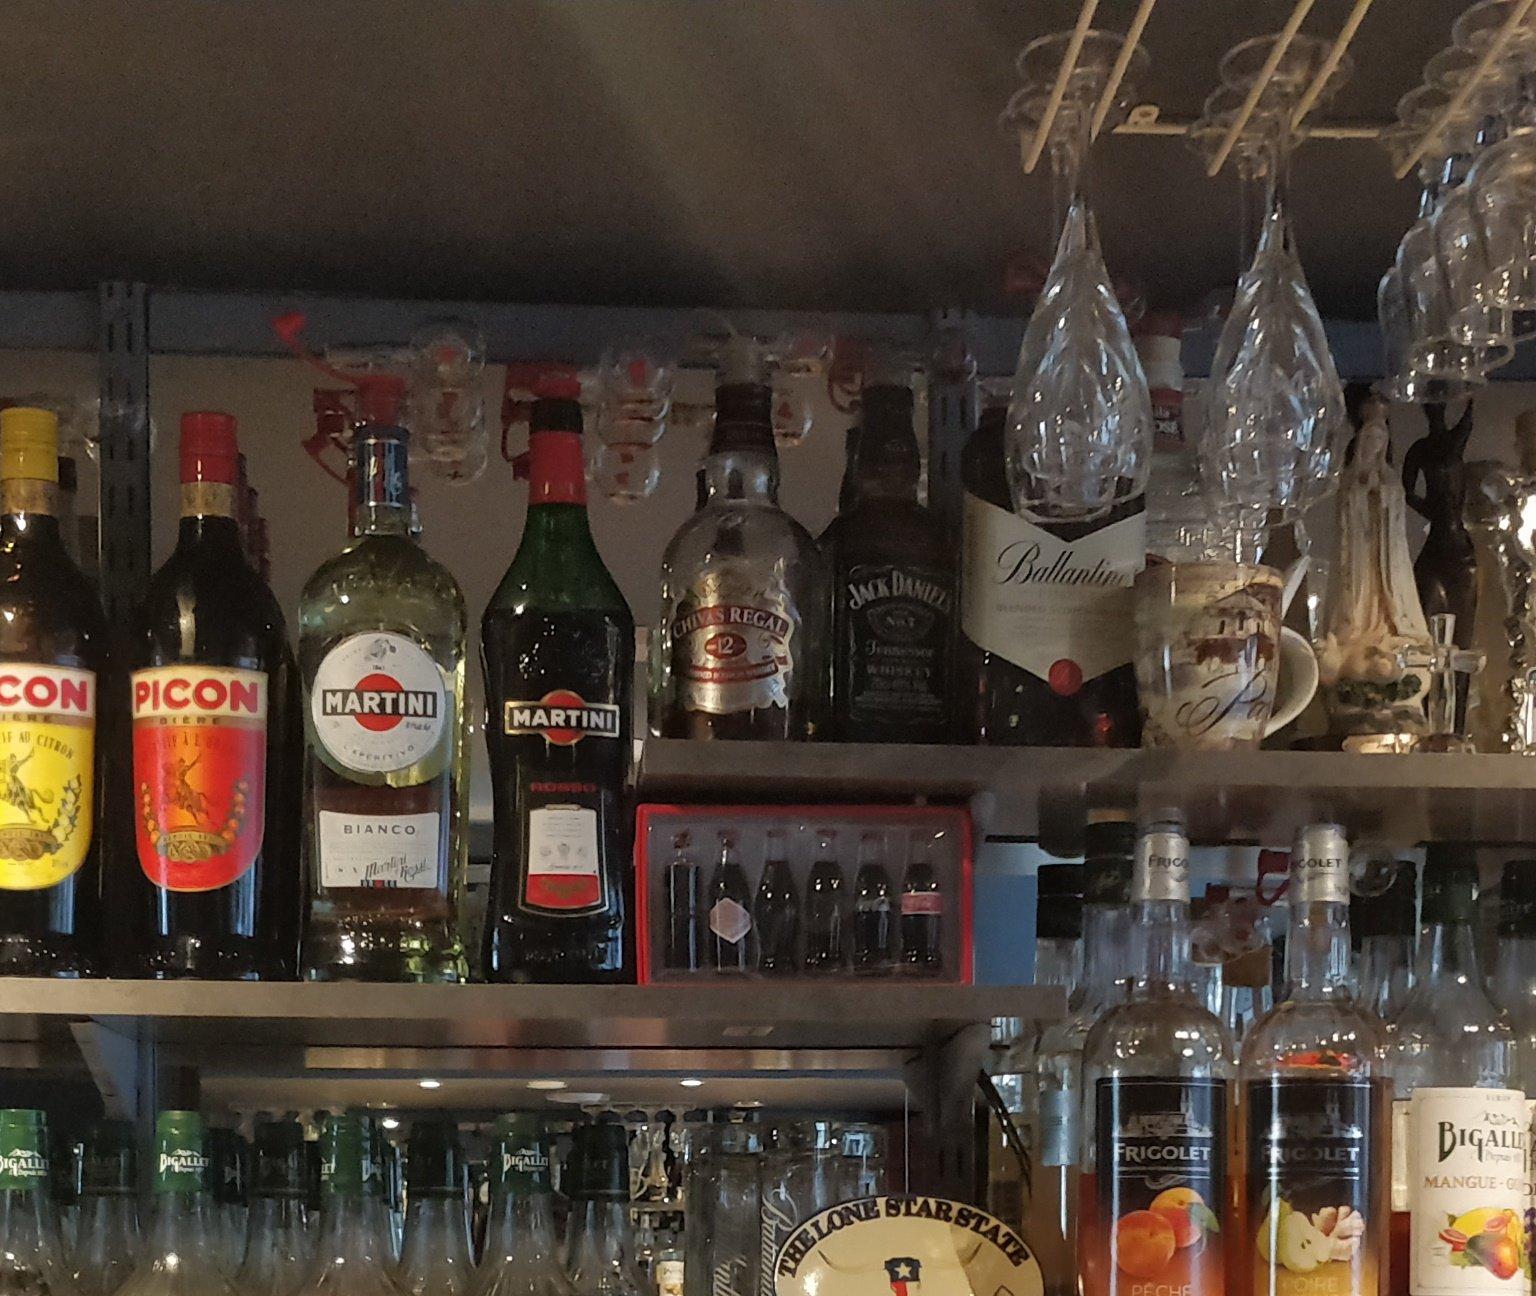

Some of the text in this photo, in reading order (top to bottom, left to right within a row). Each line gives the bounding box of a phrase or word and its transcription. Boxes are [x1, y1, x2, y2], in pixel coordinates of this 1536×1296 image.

[848, 579, 890, 611] JACK
[672, 606, 786, 640] CHIVAS REGAL
[134, 678, 259, 714] PICON
[325, 691, 435, 717] MARTINI
[514, 708, 613, 729] MARTINI
[18, 731, 32, 744] AU
[343, 824, 416, 836] BIANCO
[1113, 1143, 1211, 1163] FRIGOLET
[1424, 1175, 1497, 1190] MANGUE
[777, 1197, 1031, 1279] THE LONE STAR STATE
